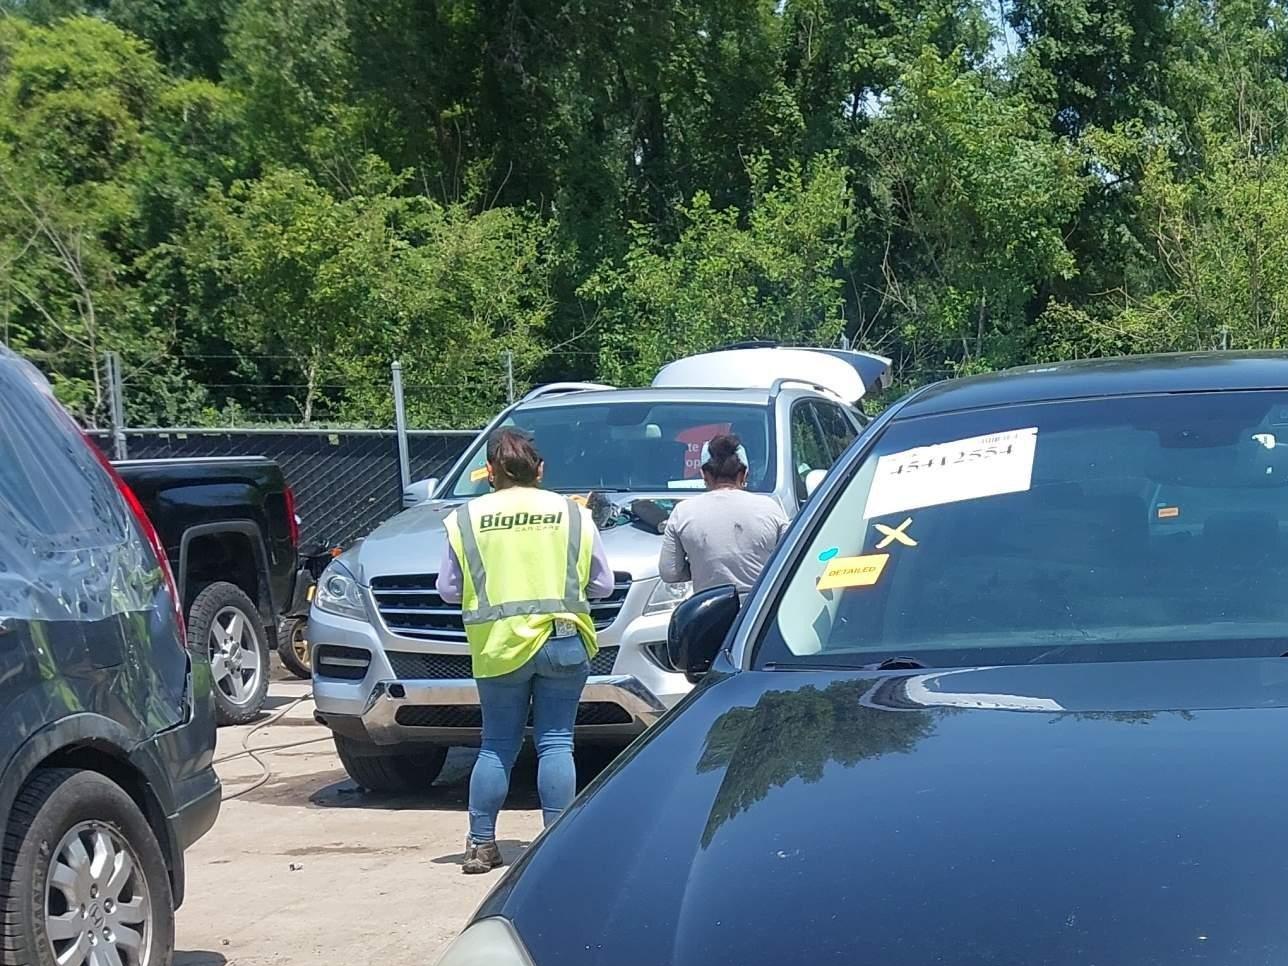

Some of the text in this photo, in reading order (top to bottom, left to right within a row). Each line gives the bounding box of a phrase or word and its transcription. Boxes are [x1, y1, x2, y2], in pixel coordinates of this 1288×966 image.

[889, 444, 1012, 475] 45412554
[479, 511, 562, 533] BigDeal
[828, 566, 877, 577] DETAILED
